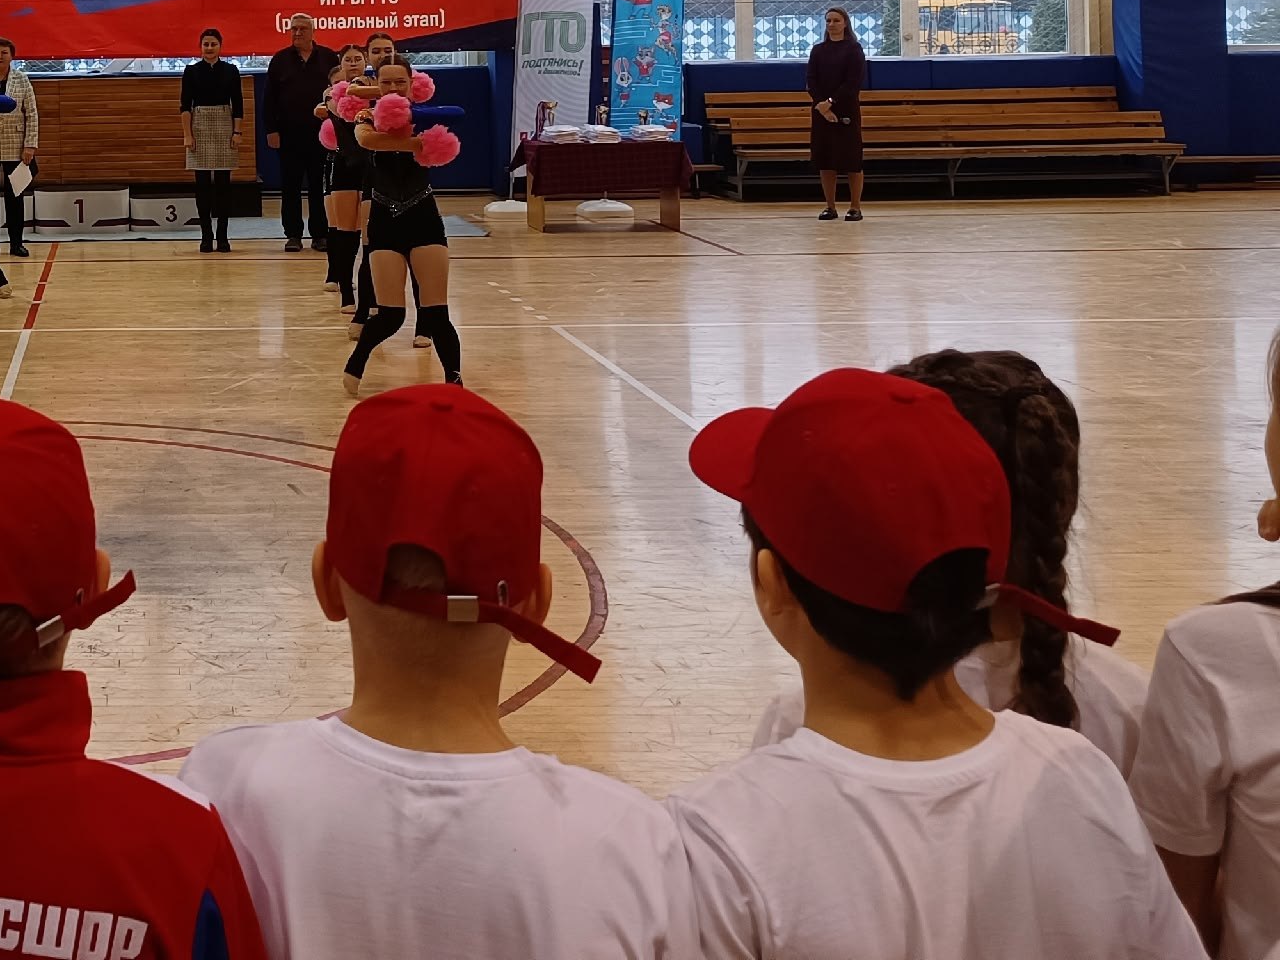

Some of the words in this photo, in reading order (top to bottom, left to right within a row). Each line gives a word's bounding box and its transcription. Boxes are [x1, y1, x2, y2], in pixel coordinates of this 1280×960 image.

[276, 12, 399, 33] (рональный
[403, 8, 445, 29] этап)
[522, 11, 586, 55] ГТО
[73, 199, 84, 224] 1
[165, 204, 177, 223] 3
